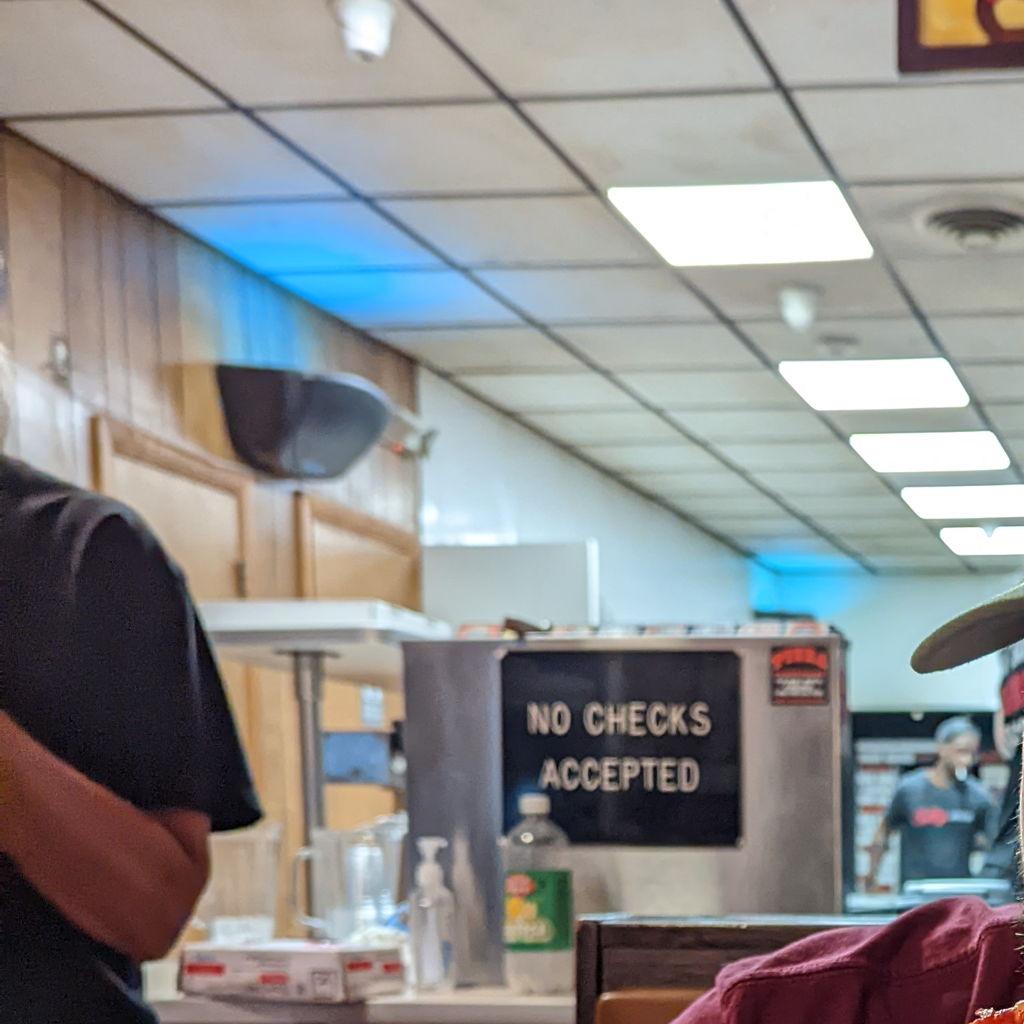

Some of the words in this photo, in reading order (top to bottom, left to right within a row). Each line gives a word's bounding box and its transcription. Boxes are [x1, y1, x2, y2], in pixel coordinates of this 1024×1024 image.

[527, 701, 572, 736] NO
[583, 701, 712, 738] CHECKS
[539, 757, 701, 794] ACCEPTED
